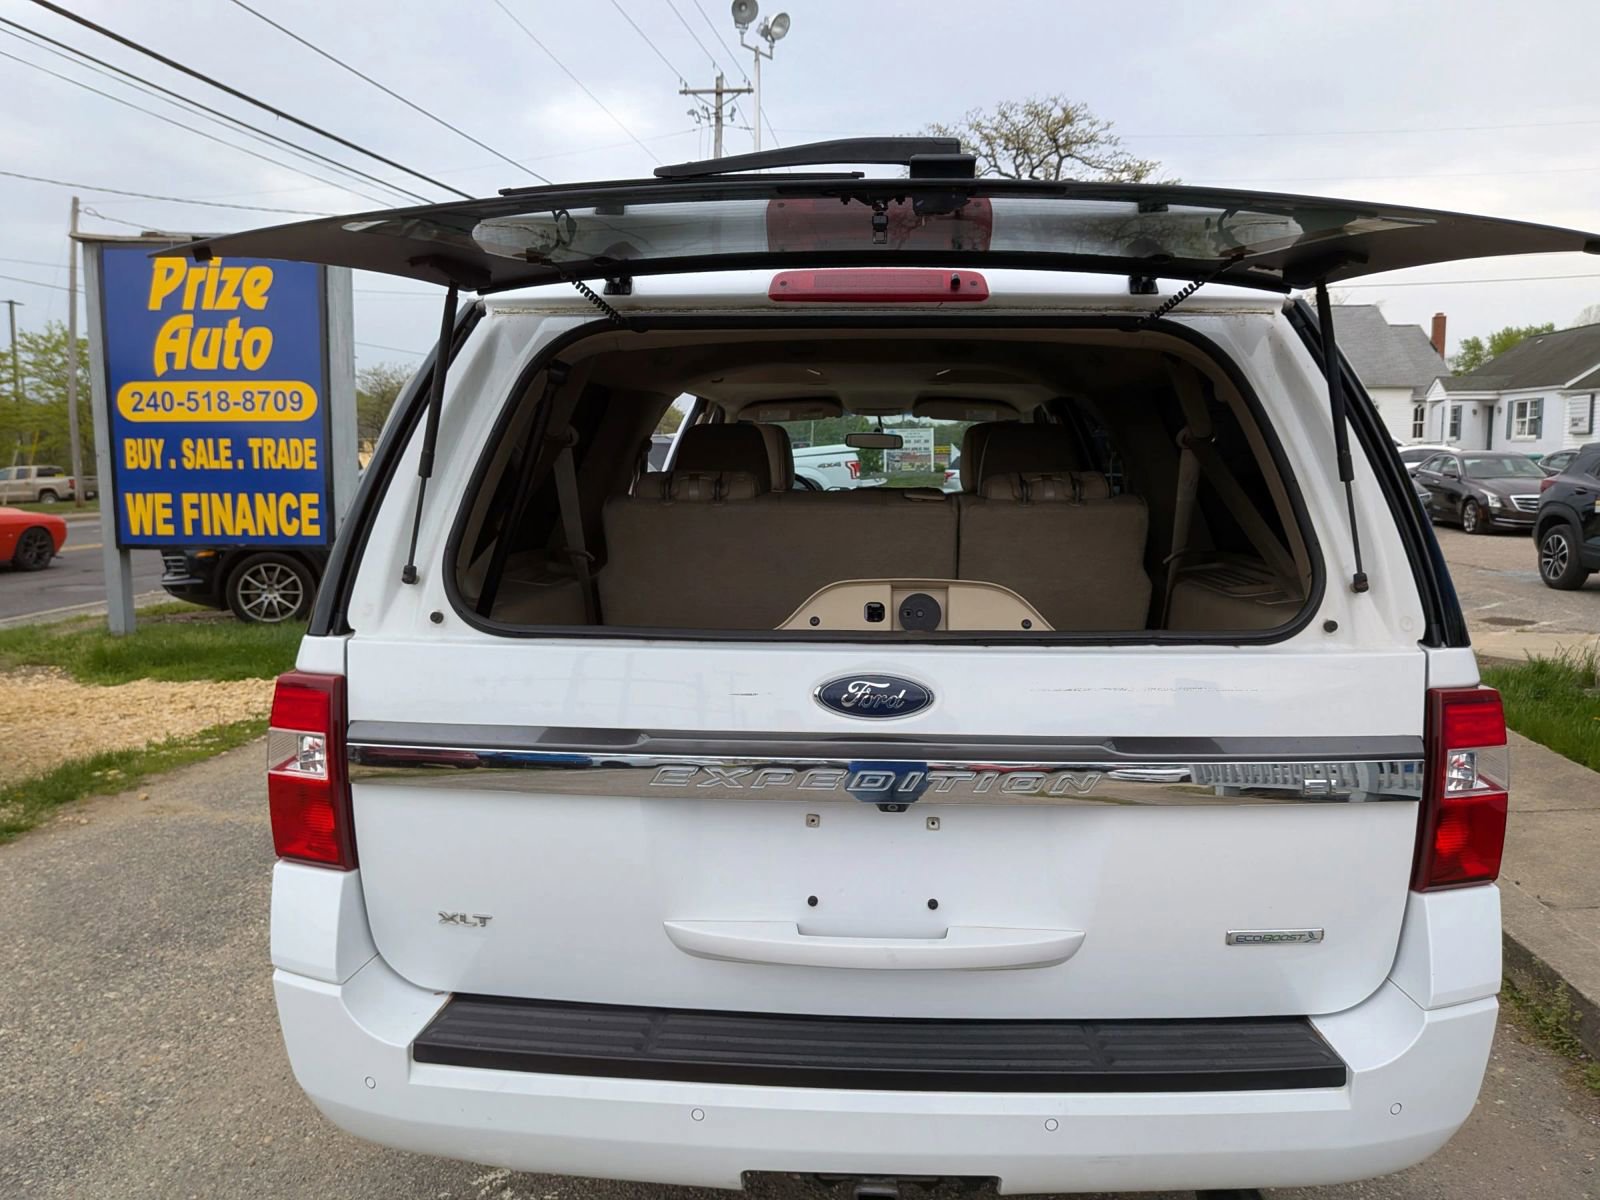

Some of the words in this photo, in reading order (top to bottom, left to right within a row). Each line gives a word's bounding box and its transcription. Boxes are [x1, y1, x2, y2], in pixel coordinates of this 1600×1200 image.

[148, 256, 273, 310] Prize
[153, 314, 273, 377] Auto
[130, 390, 303, 412] 240-518-8709
[181, 437, 232, 470] SALE
[248, 437, 317, 470] TRADE
[124, 492, 175, 536] WE
[181, 492, 321, 536] FINANCE
[841, 680, 906, 709] Ford
[648, 765, 1101, 795] EXPEDITION
[438, 911, 493, 927] XLT
[1235, 933, 1306, 943] ECOBOOST
